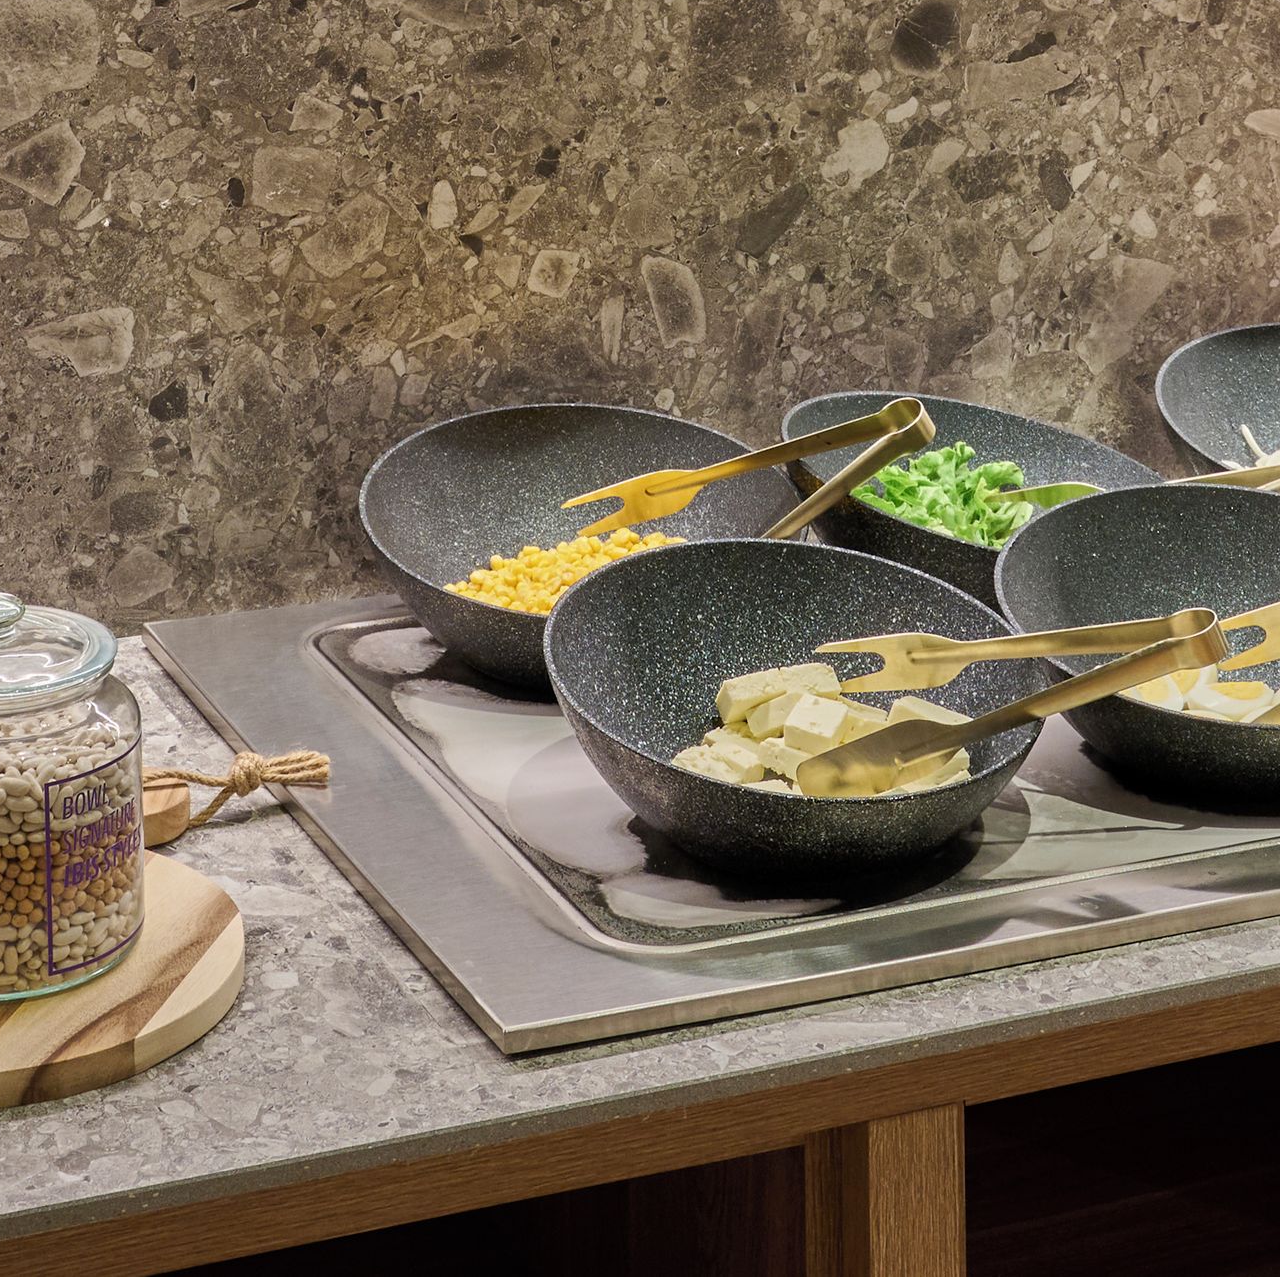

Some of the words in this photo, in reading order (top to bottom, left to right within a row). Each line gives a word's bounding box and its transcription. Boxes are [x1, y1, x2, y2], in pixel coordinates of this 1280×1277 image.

[62, 797, 135, 854] SIGNATURE
[63, 854, 100, 888] IBIS
[103, 823, 141, 873] STYLES
